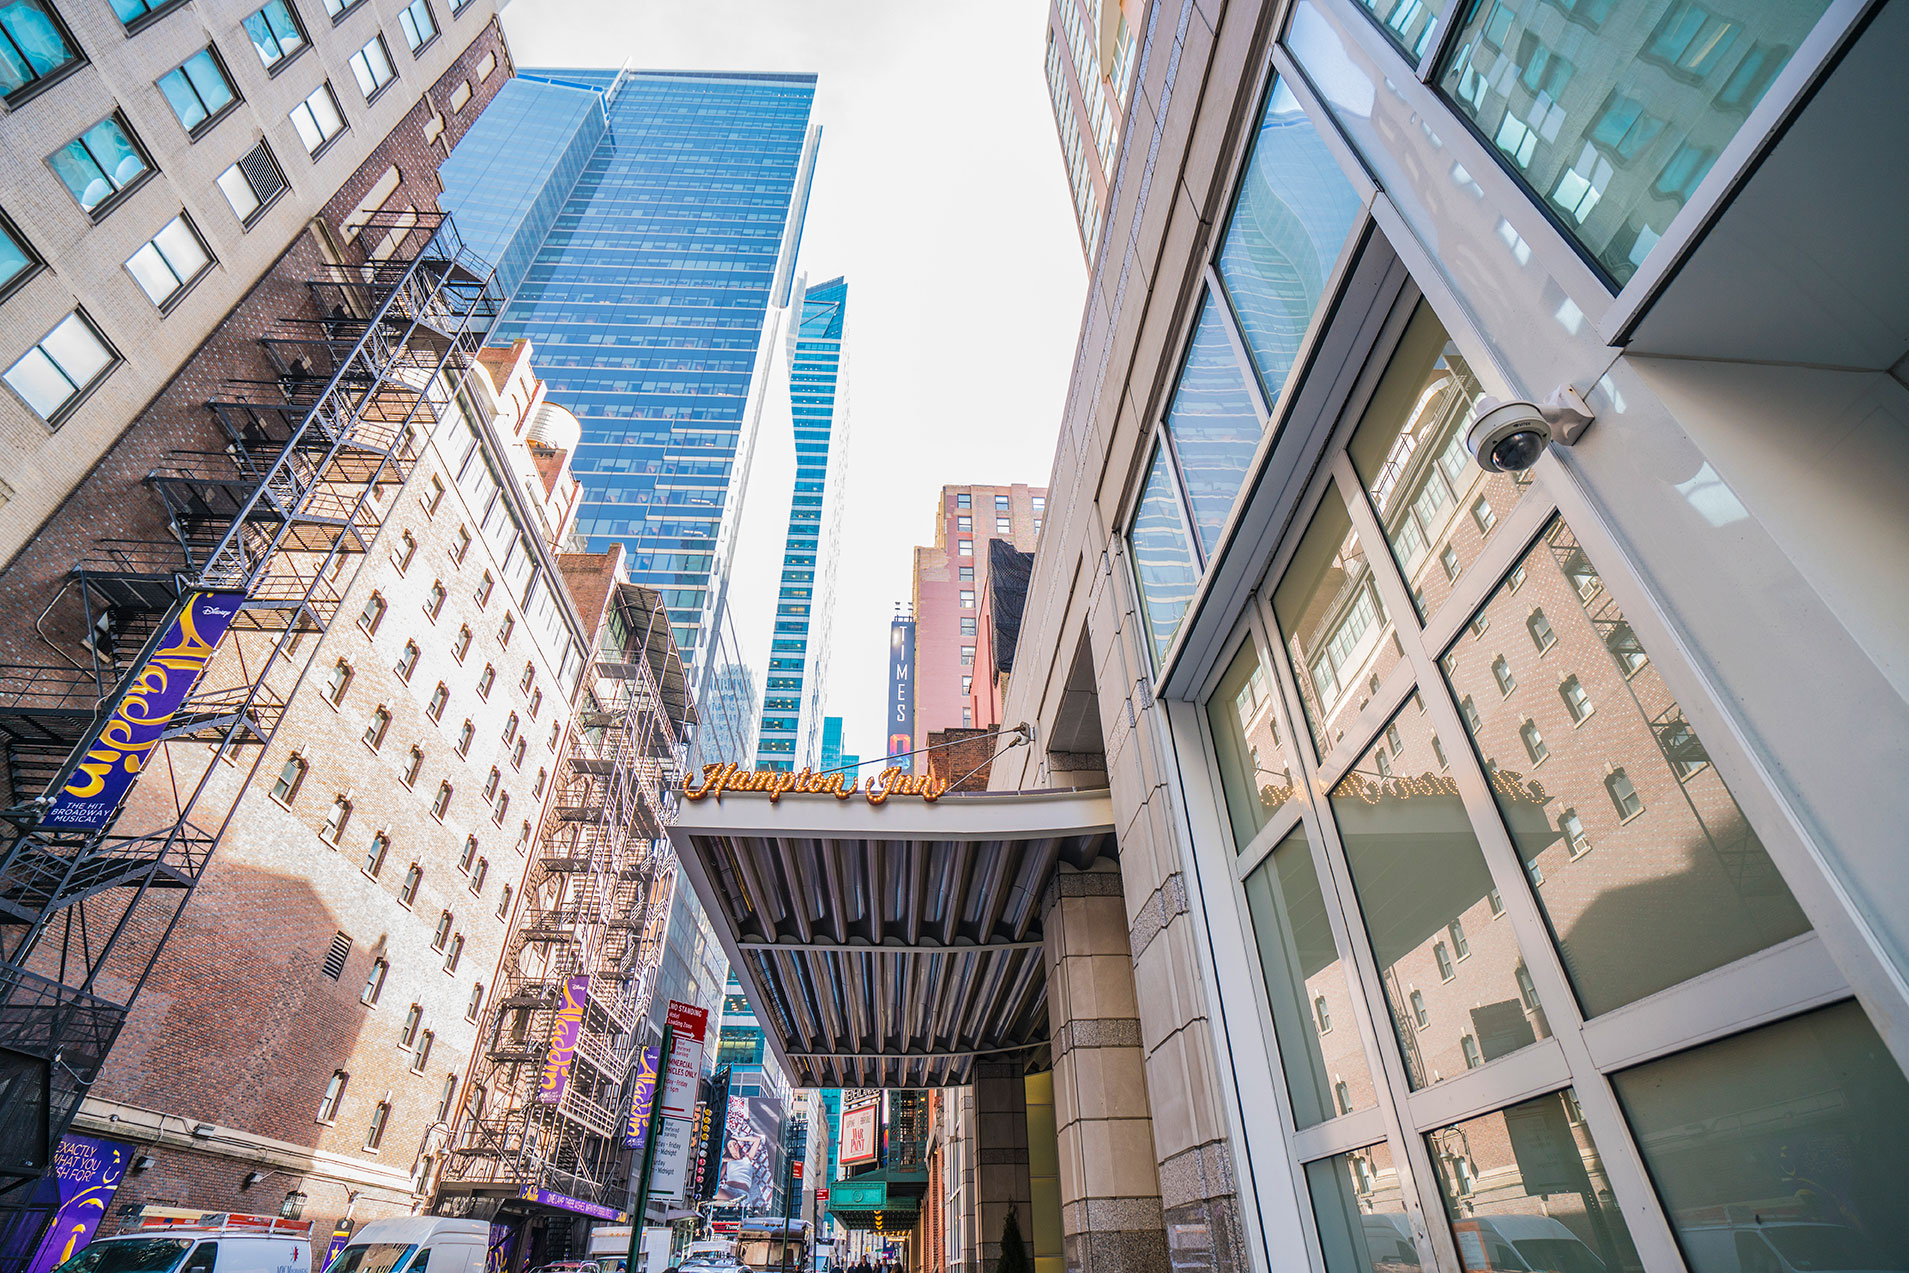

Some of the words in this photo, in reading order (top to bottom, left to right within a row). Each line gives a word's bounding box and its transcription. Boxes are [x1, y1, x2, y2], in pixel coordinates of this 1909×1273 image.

[202, 605, 232, 618] Disney
[896, 625, 908, 722] TIMES
[683, 761, 858, 805] Hampton
[865, 766, 947, 805] Inn
[50, 808, 111, 817] BROADWAY
[66, 802, 86, 810] THE
[87, 802, 105, 810] HIT
[53, 815, 97, 823] MUSICAL
[678, 1005, 702, 1018] STANDING
[80, 1157, 102, 1171] YOU
